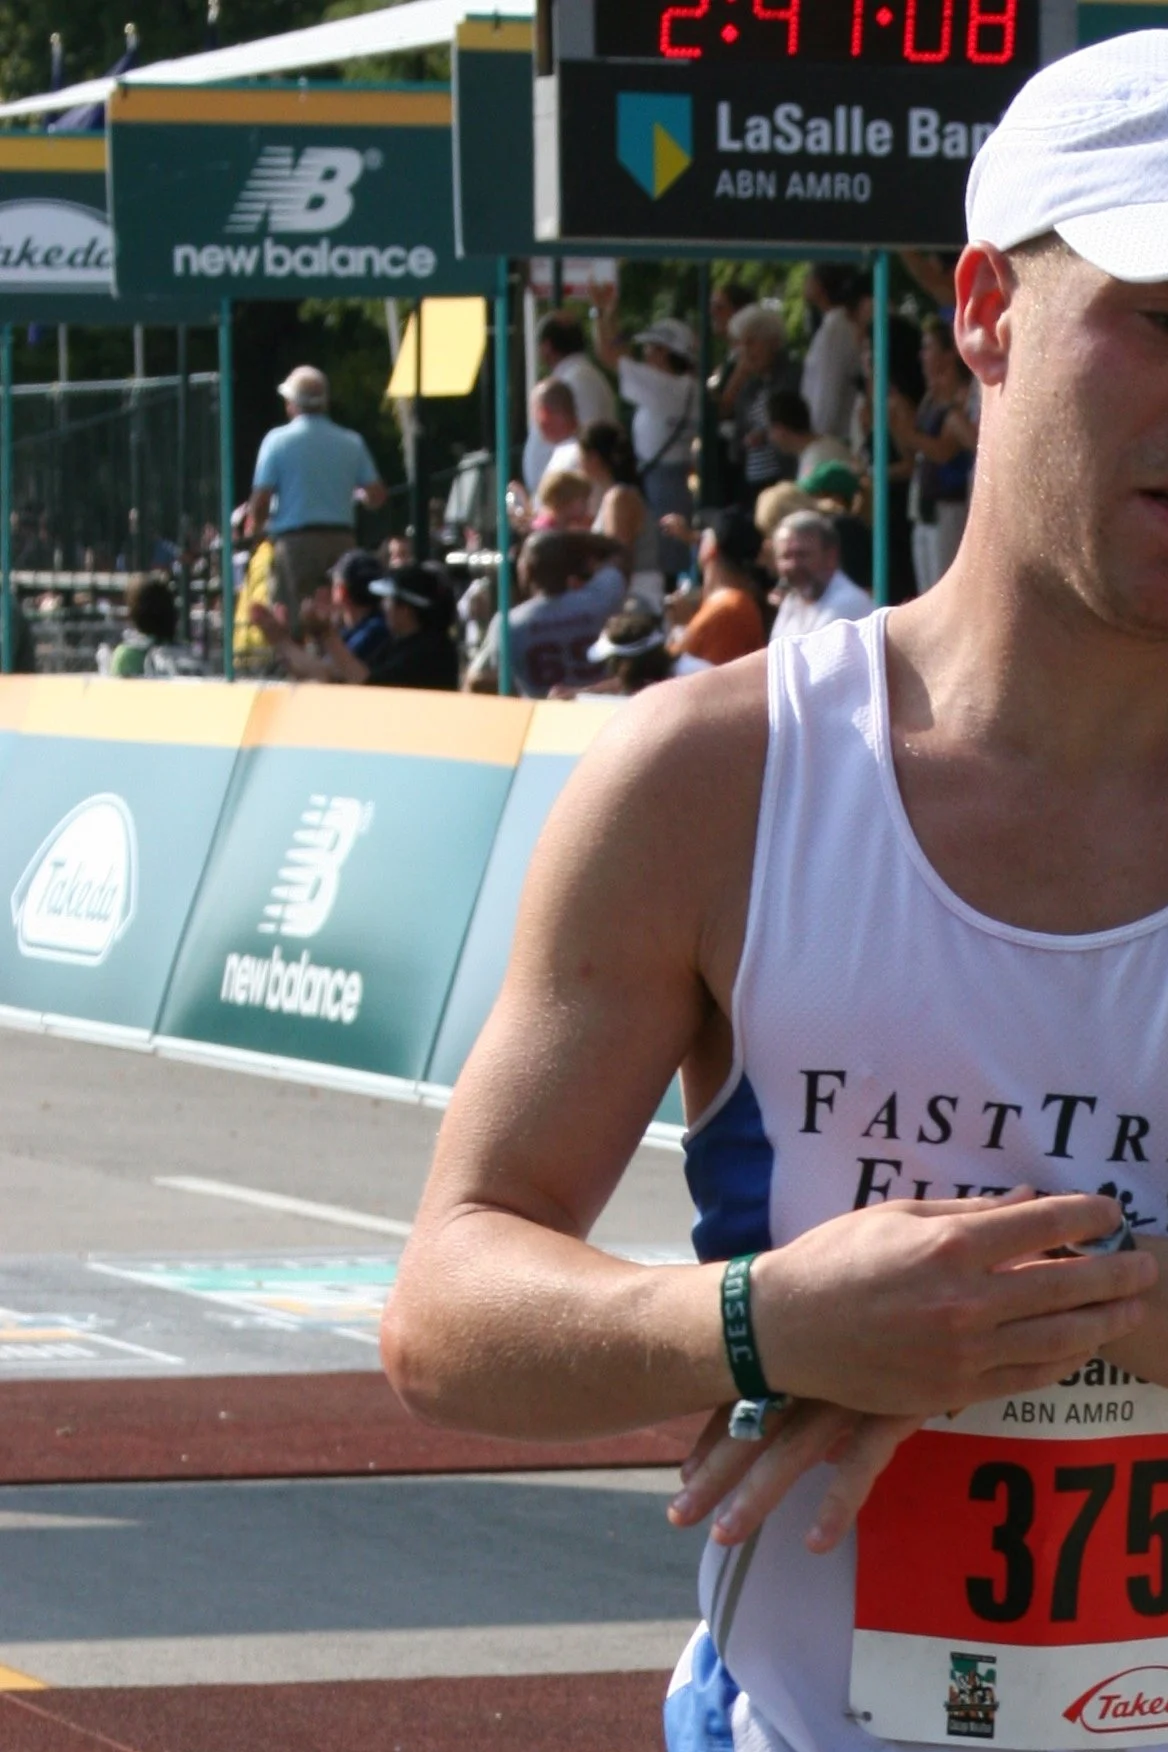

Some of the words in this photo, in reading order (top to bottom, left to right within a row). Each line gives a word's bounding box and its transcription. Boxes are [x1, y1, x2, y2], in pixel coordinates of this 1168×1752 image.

[716, 101, 892, 157] LaSalle
[907, 107, 998, 160] Ban
[715, 170, 776, 199] ABN
[785, 171, 872, 203] AMRO
[173, 244, 260, 276] new
[262, 237, 437, 278] balance
[36, 857, 119, 922] Takeda
[220, 952, 268, 1007] new
[263, 945, 363, 1025] balance
[723, 1260, 754, 1364] JESUS
[1002, 1401, 1056, 1425] ABN
[1064, 1399, 1135, 1424] AMRO
